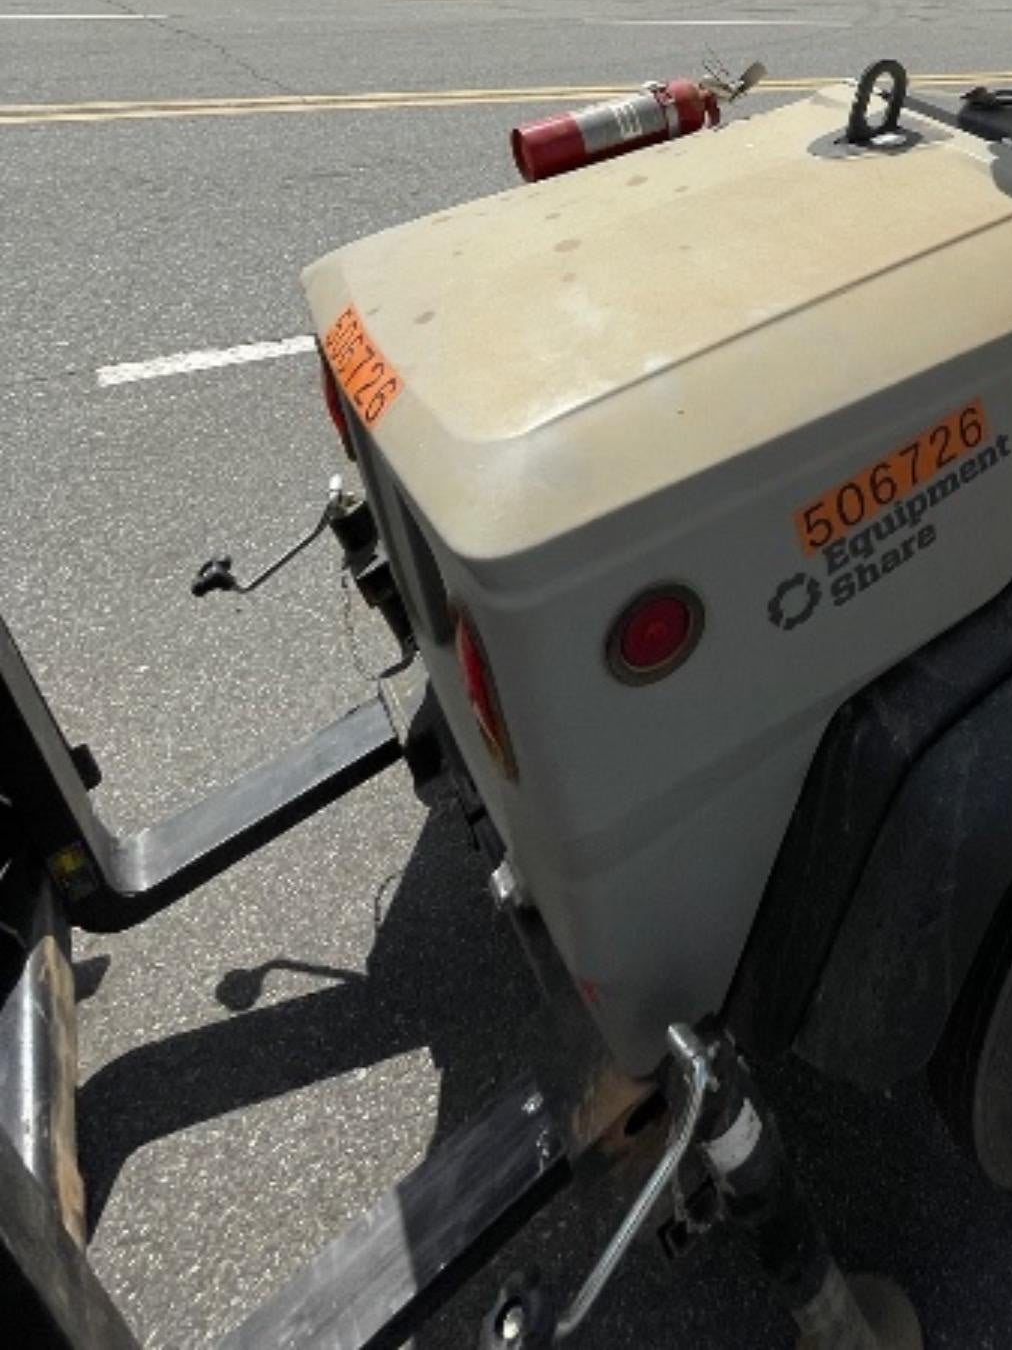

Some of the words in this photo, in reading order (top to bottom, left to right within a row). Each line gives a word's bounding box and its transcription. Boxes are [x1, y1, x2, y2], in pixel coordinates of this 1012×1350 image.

[803, 407, 982, 547] 506726
[822, 434, 1012, 576] Equipment
[830, 523, 937, 607] Share
